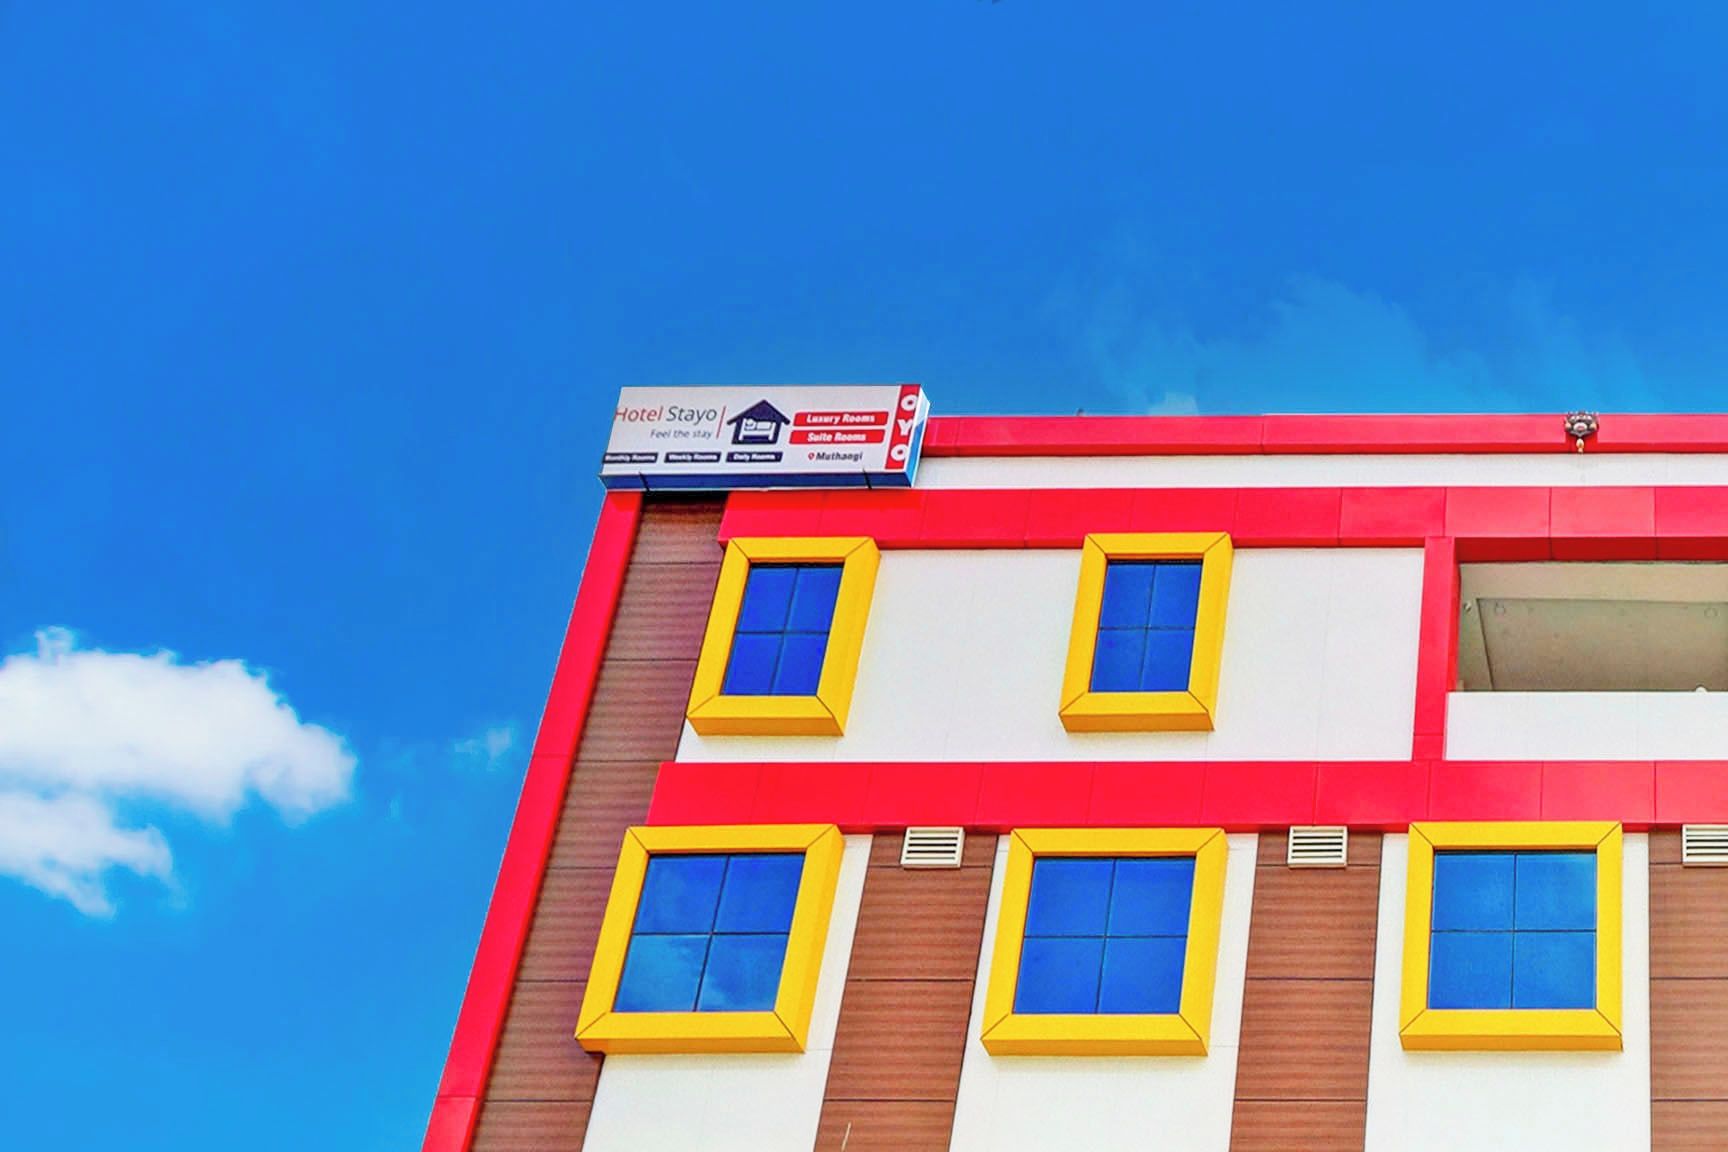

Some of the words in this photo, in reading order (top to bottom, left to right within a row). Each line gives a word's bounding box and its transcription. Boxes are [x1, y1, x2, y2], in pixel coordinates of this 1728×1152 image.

[614, 405, 663, 422] Hotel
[666, 405, 718, 426] Stayo
[806, 413, 841, 425] Luxury
[842, 413, 875, 424] Rooms
[650, 429, 671, 439] Feel
[673, 429, 690, 439] the
[692, 429, 713, 440] stay
[807, 432, 833, 443] Suite
[834, 432, 867, 442] Rooms
[815, 451, 864, 462] Muthangi
